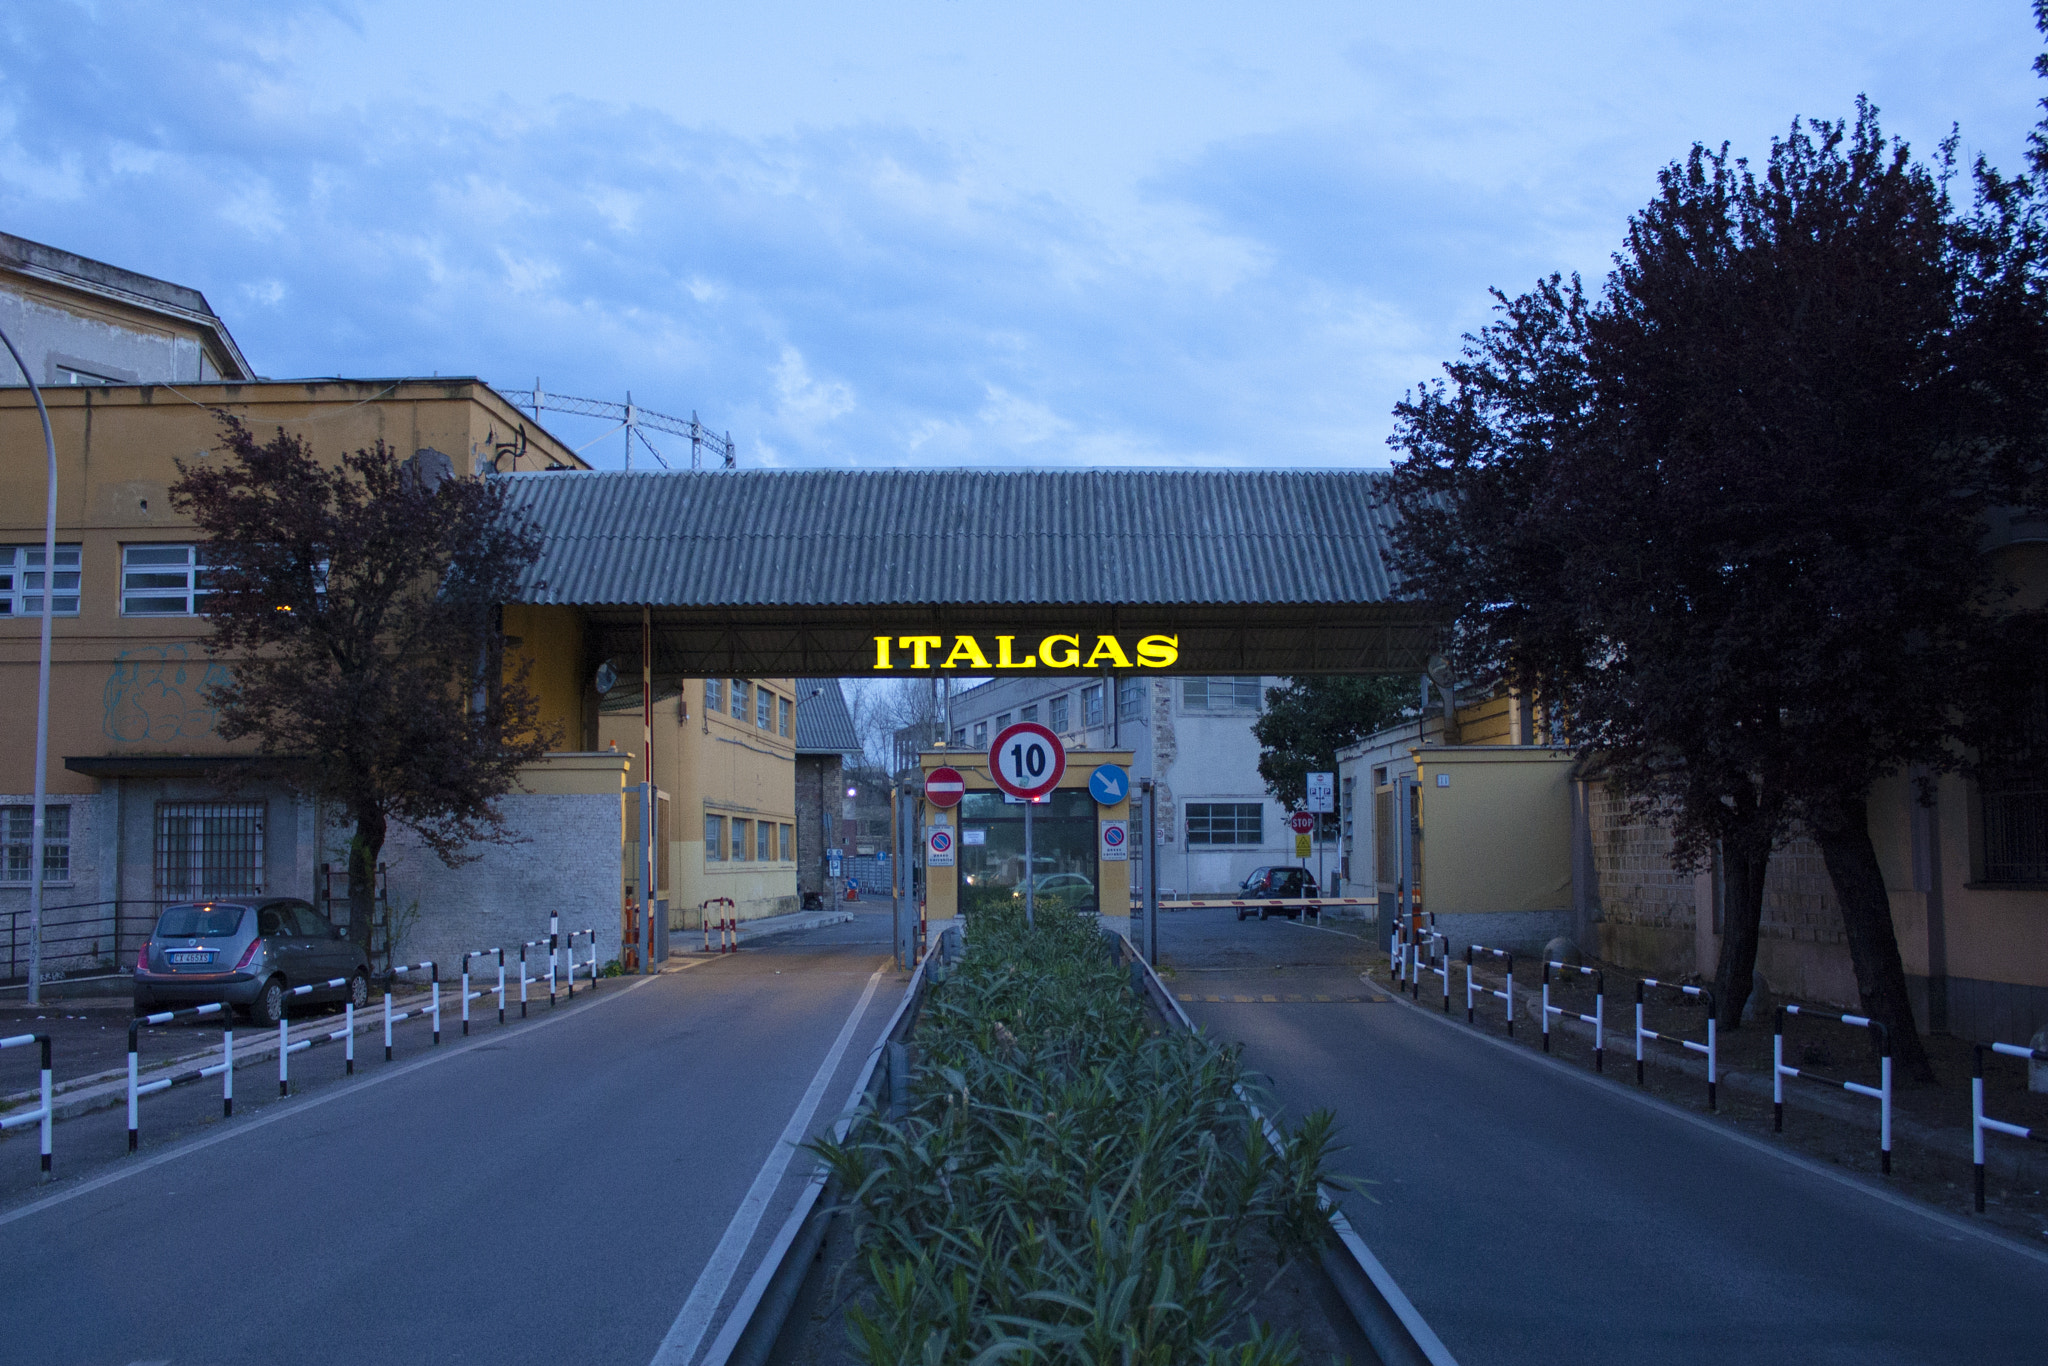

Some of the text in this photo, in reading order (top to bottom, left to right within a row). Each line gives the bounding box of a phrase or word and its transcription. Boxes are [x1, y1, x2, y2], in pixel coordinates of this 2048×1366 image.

[873, 633, 1178, 669] ITALGAS
[1011, 743, 1046, 778] 10
[1293, 818, 1313, 828] STOP
